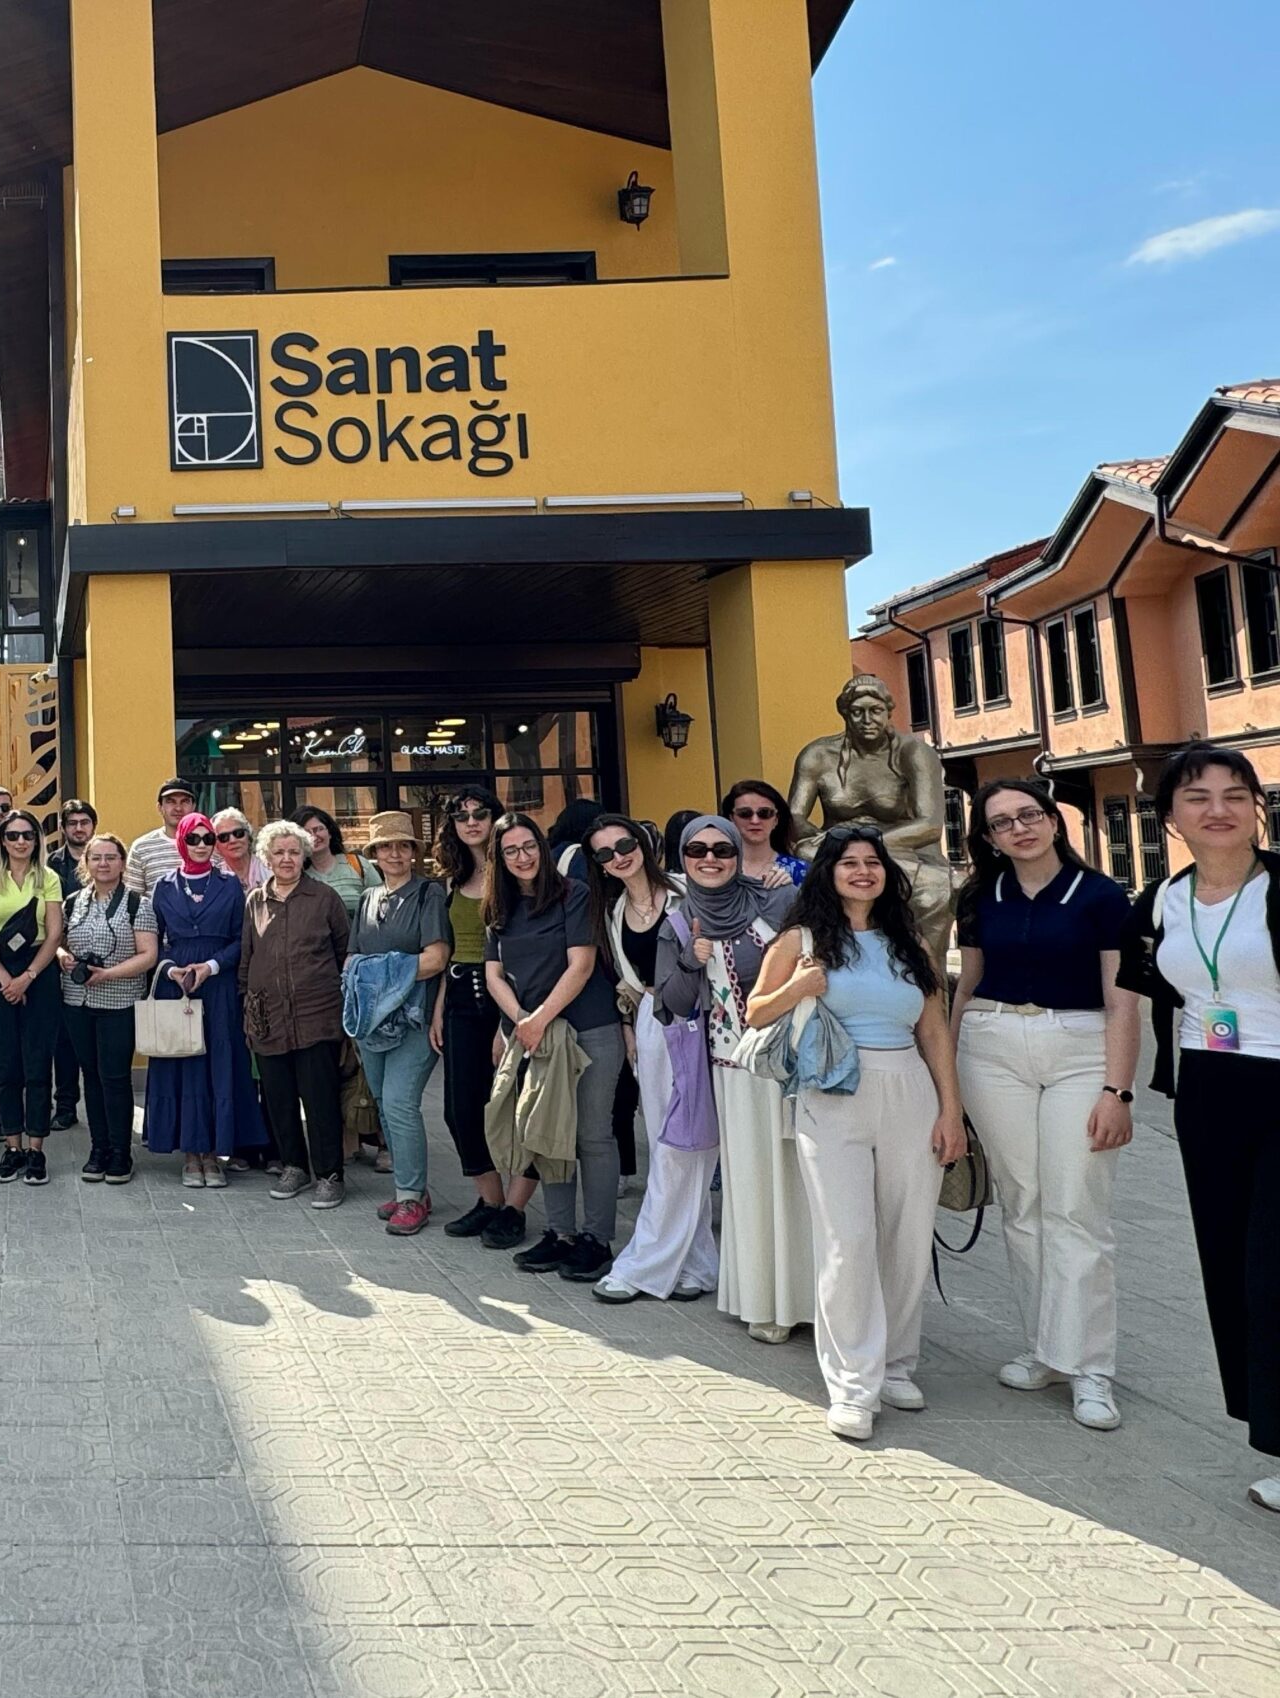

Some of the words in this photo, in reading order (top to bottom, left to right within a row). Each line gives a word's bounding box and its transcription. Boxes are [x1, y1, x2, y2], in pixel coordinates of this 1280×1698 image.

[270, 330, 507, 397] Sanat
[274, 399, 529, 477] Sokağı
[400, 745, 432, 755] GLASS
